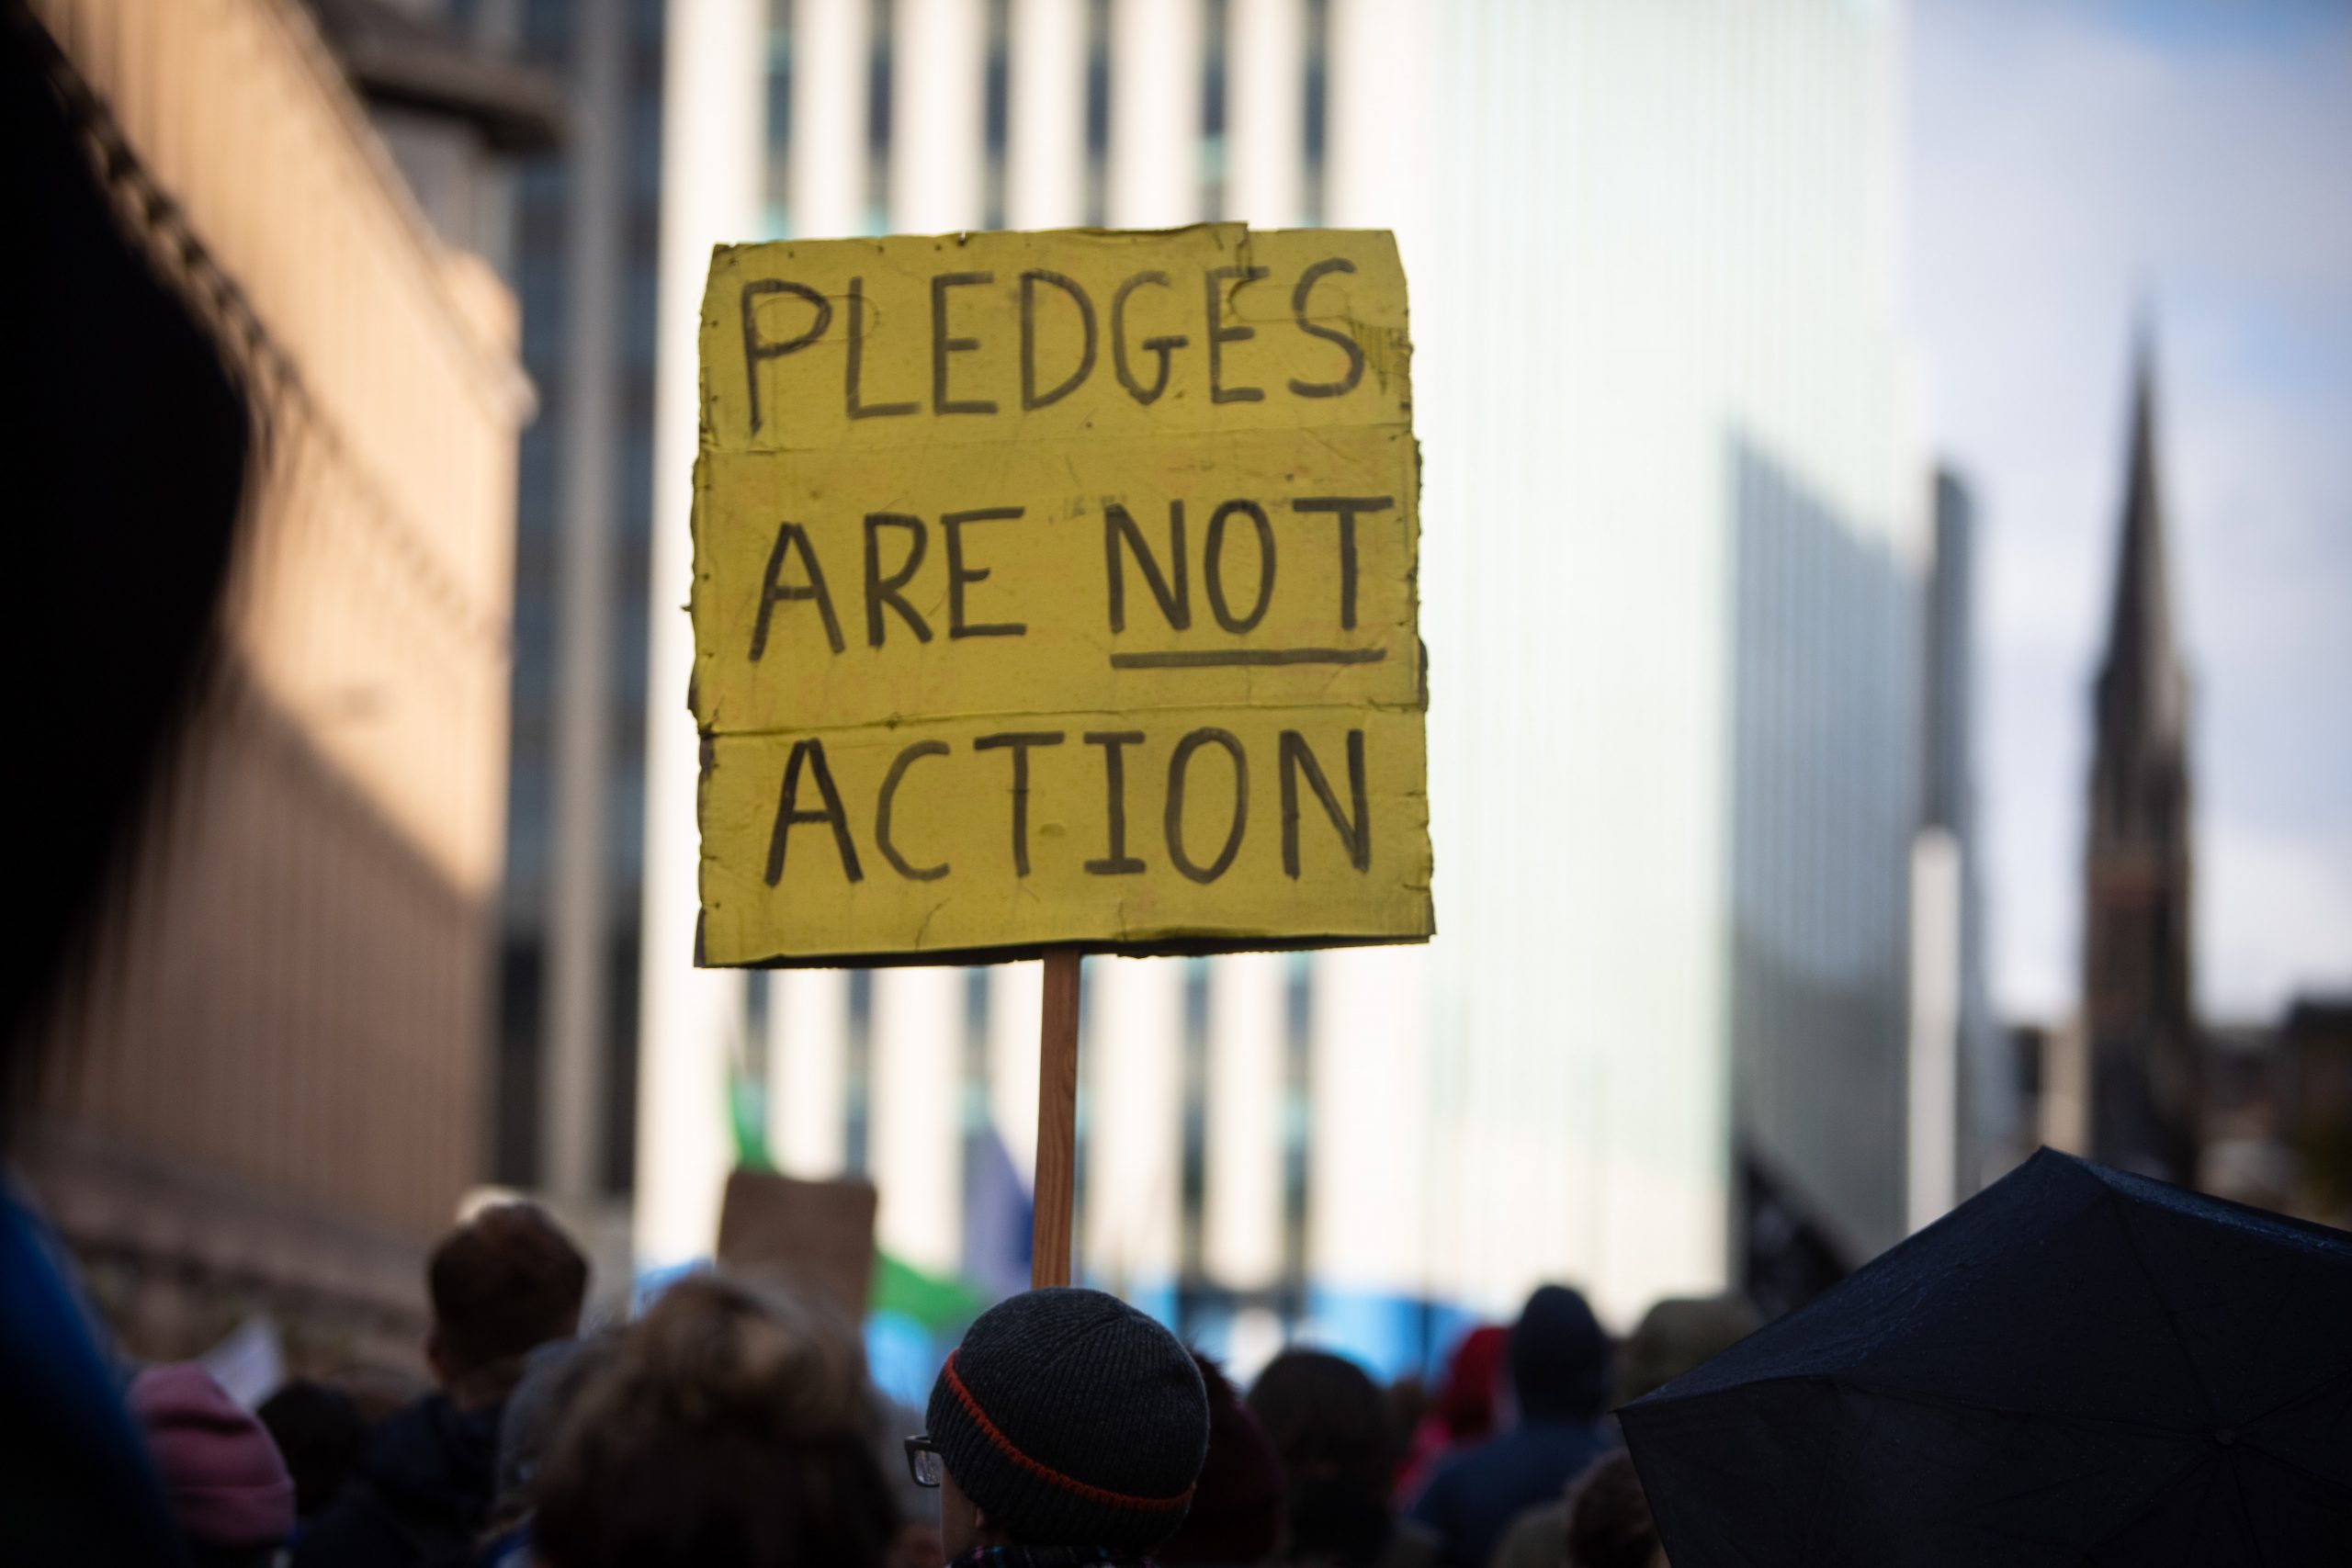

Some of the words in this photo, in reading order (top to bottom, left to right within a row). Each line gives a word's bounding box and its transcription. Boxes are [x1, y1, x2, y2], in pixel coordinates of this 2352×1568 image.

[741, 258, 1365, 434] PLEDGES
[749, 507, 1027, 661] ARE
[1105, 496, 1395, 634] NOT
[765, 728, 1369, 887] ACTION
